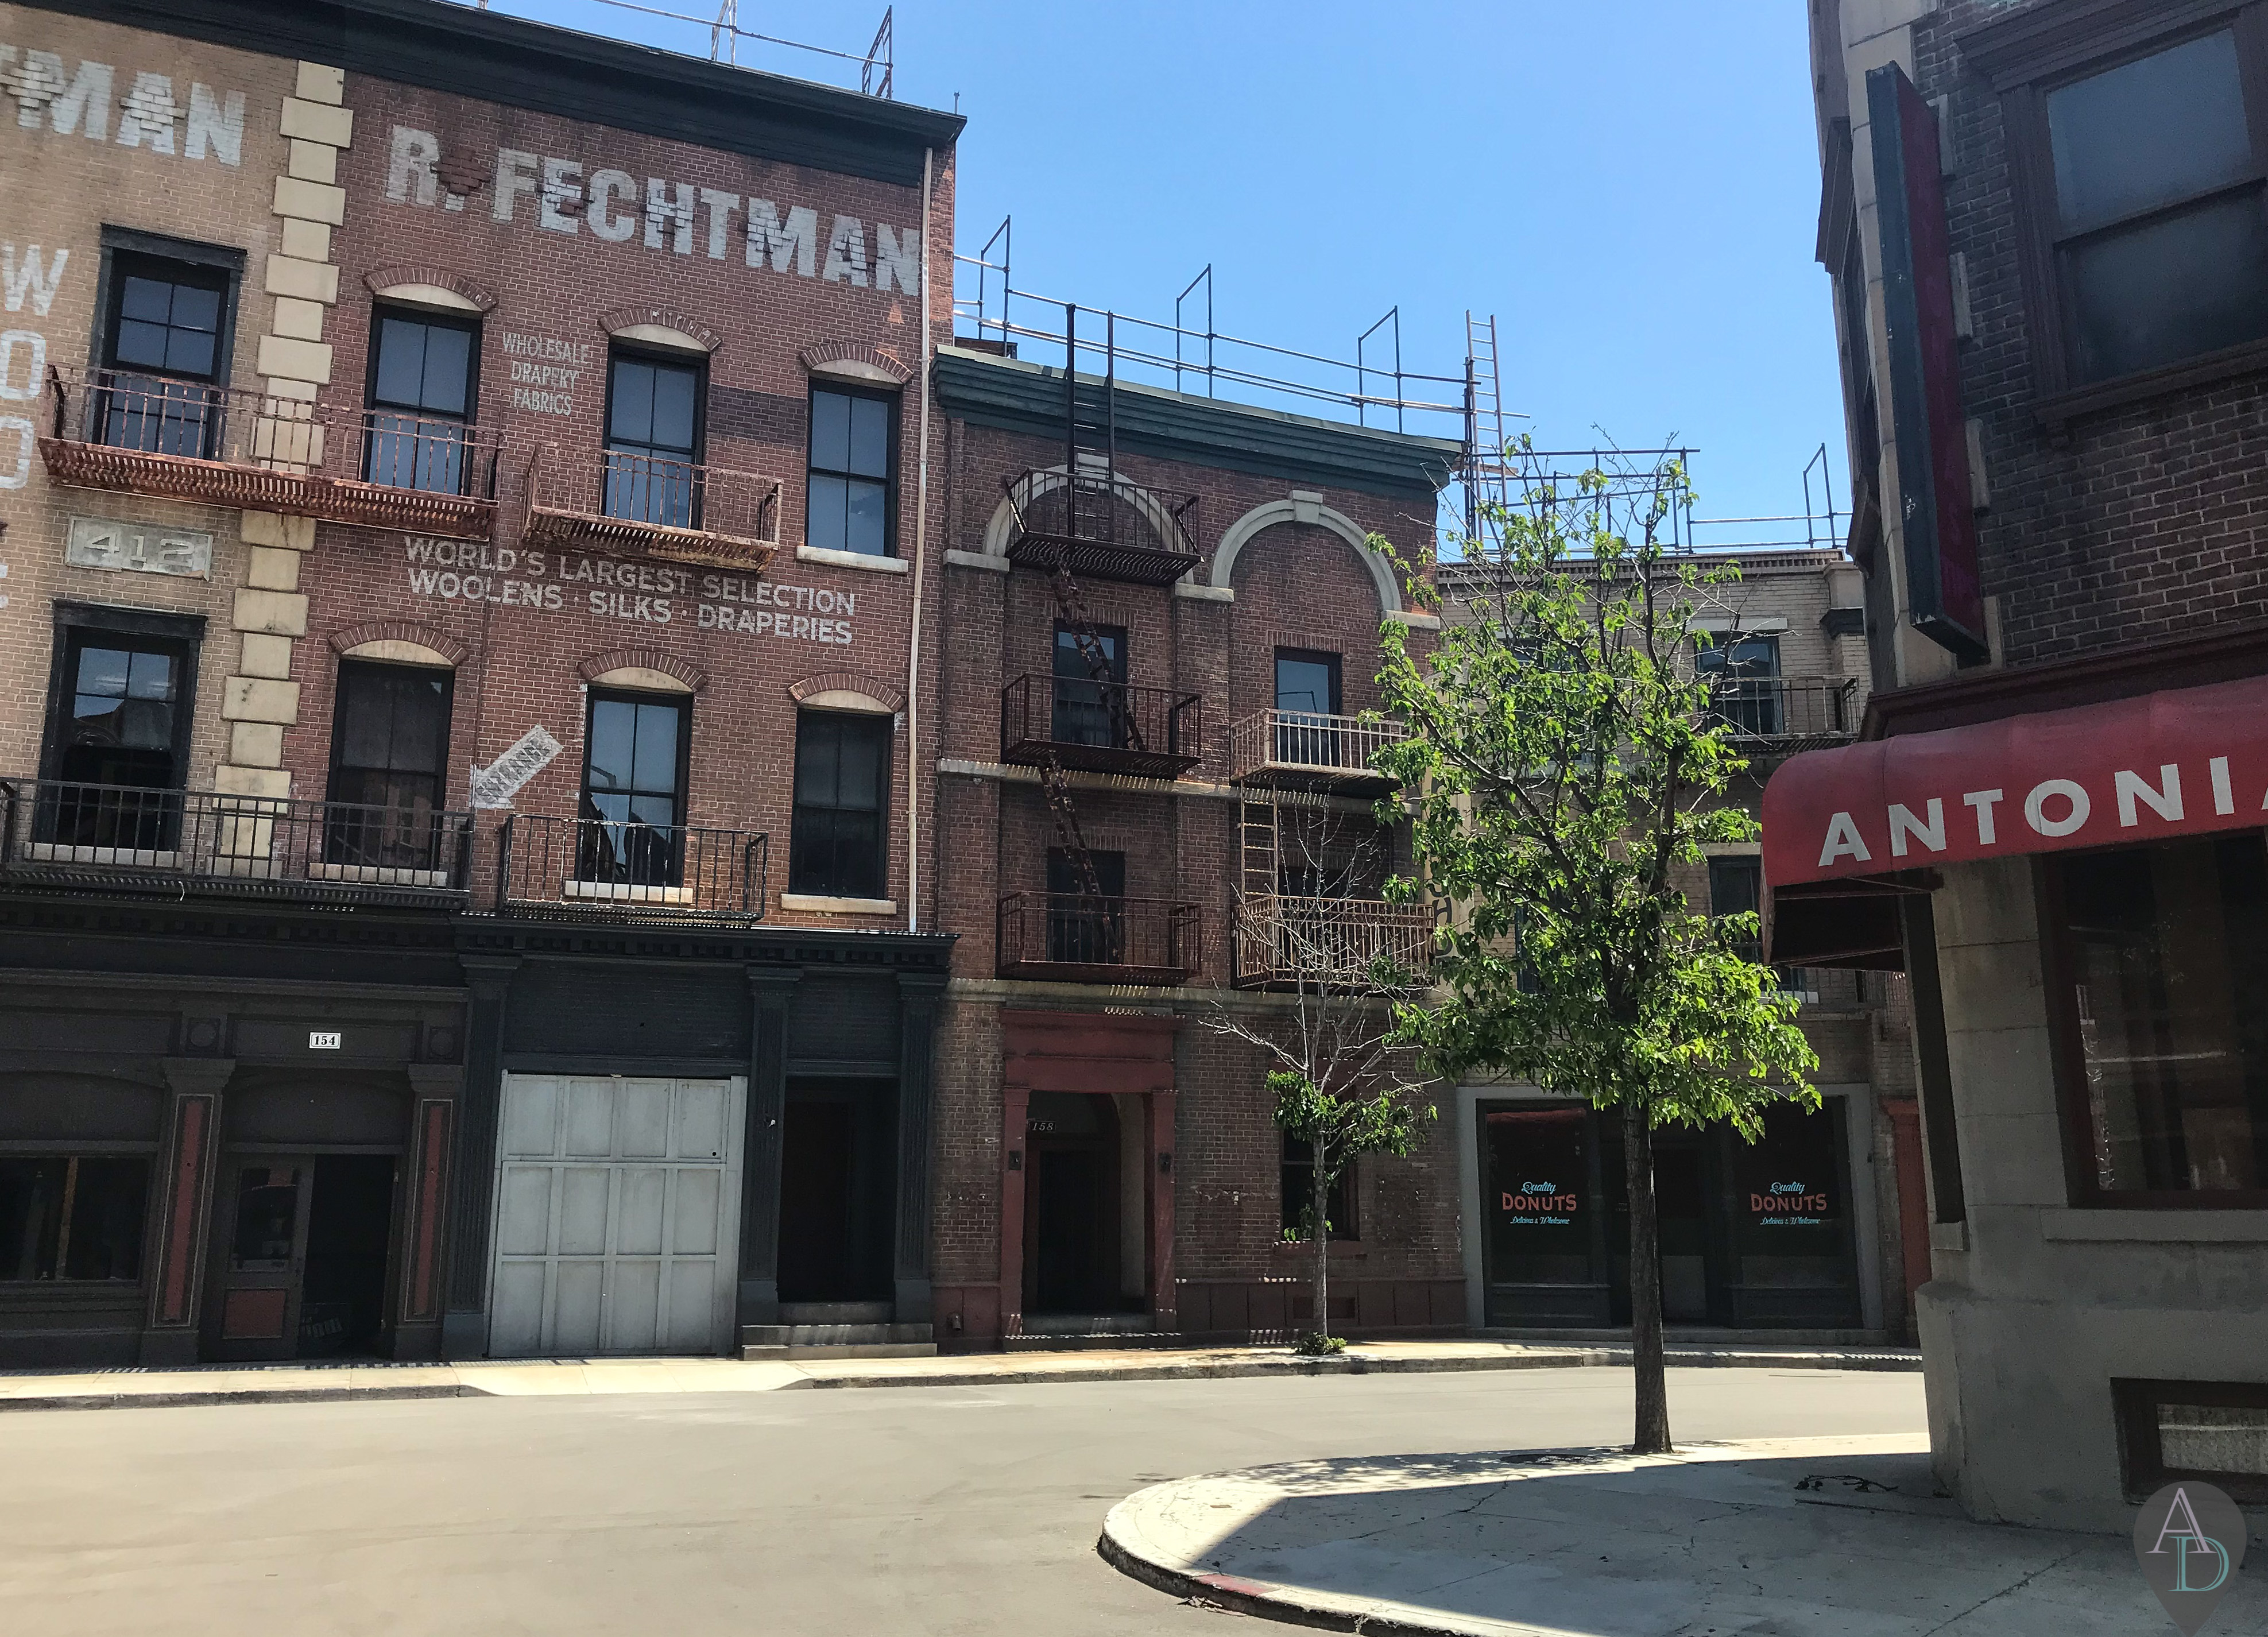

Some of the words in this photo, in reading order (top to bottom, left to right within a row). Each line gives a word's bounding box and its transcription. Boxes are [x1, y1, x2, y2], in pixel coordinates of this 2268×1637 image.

[492, 147, 920, 297] FECHTMAN
[503, 332, 589, 364] WHOLESALE
[512, 361, 579, 390] DRAPERY
[514, 388, 572, 416] FABRICS
[84, 532, 195, 567] 412
[405, 536, 546, 576] WORLD'S
[560, 556, 692, 594] LARGEST
[703, 575, 855, 616] SELECTION
[408, 568, 563, 609] WOOLENS
[589, 591, 672, 623] SILKS
[698, 604, 853, 644] DRAPERIES
[1818, 756, 2268, 867] ANTONI
[315, 1035, 335, 1046] 154
[1032, 1123, 1054, 1131] 158
[1502, 1191, 1577, 1211] DONUTS
[1521, 1181, 1557, 1194] Quality
[1770, 1181, 1805, 1194] Quality
[1750, 1193, 1827, 1211] DONUTS
